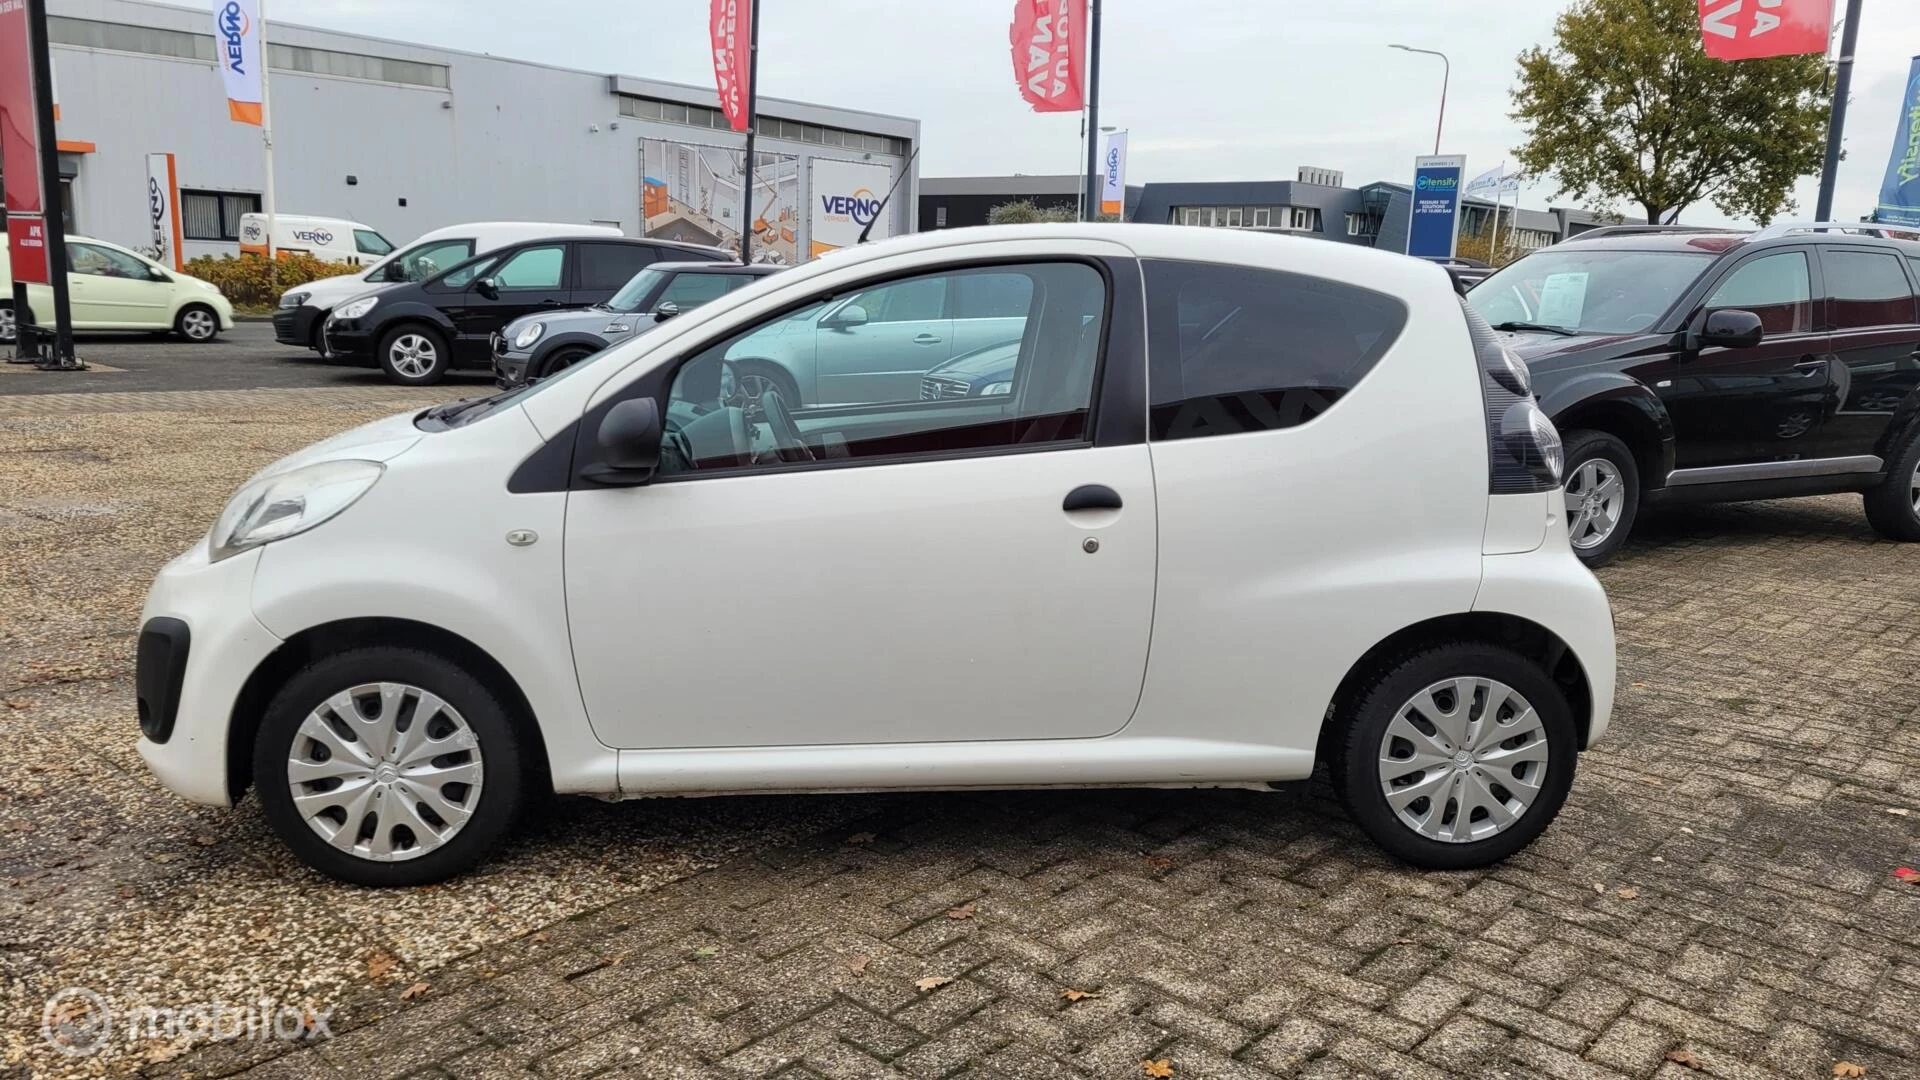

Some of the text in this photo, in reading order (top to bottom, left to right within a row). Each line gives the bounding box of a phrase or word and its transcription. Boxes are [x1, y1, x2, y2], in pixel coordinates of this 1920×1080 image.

[150, 176, 164, 262] VERNO
[822, 195, 881, 226] VERNO
[292, 230, 333, 245] VERNO
